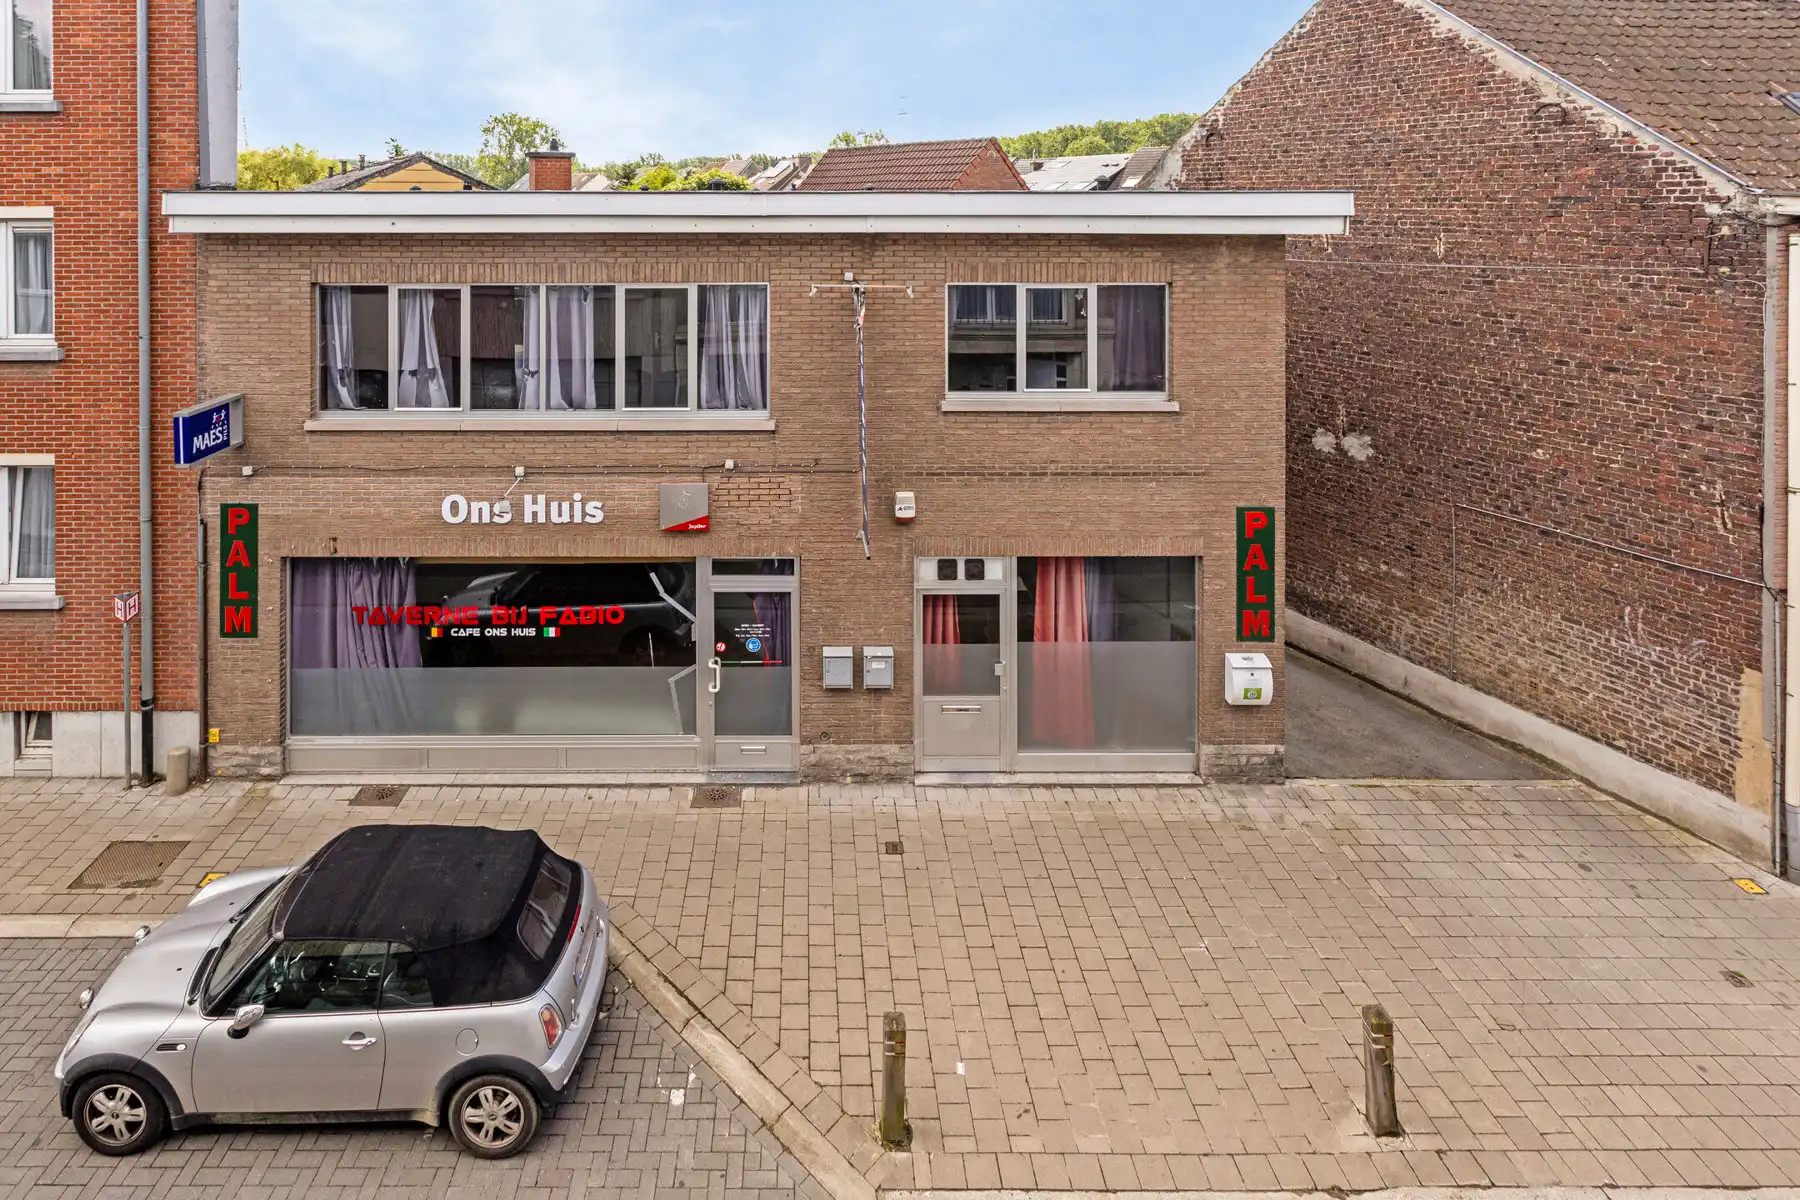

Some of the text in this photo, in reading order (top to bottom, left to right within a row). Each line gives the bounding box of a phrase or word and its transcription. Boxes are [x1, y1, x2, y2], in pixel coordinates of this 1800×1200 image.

[192, 426, 223, 454] MAES
[441, 492, 605, 524] Ons Huis
[224, 507, 253, 633] PALM
[1241, 511, 1271, 637] PALM
[351, 605, 625, 625] TAVERNE BIJ FABIO
[450, 628, 536, 637] CAFE ONS HUIS
